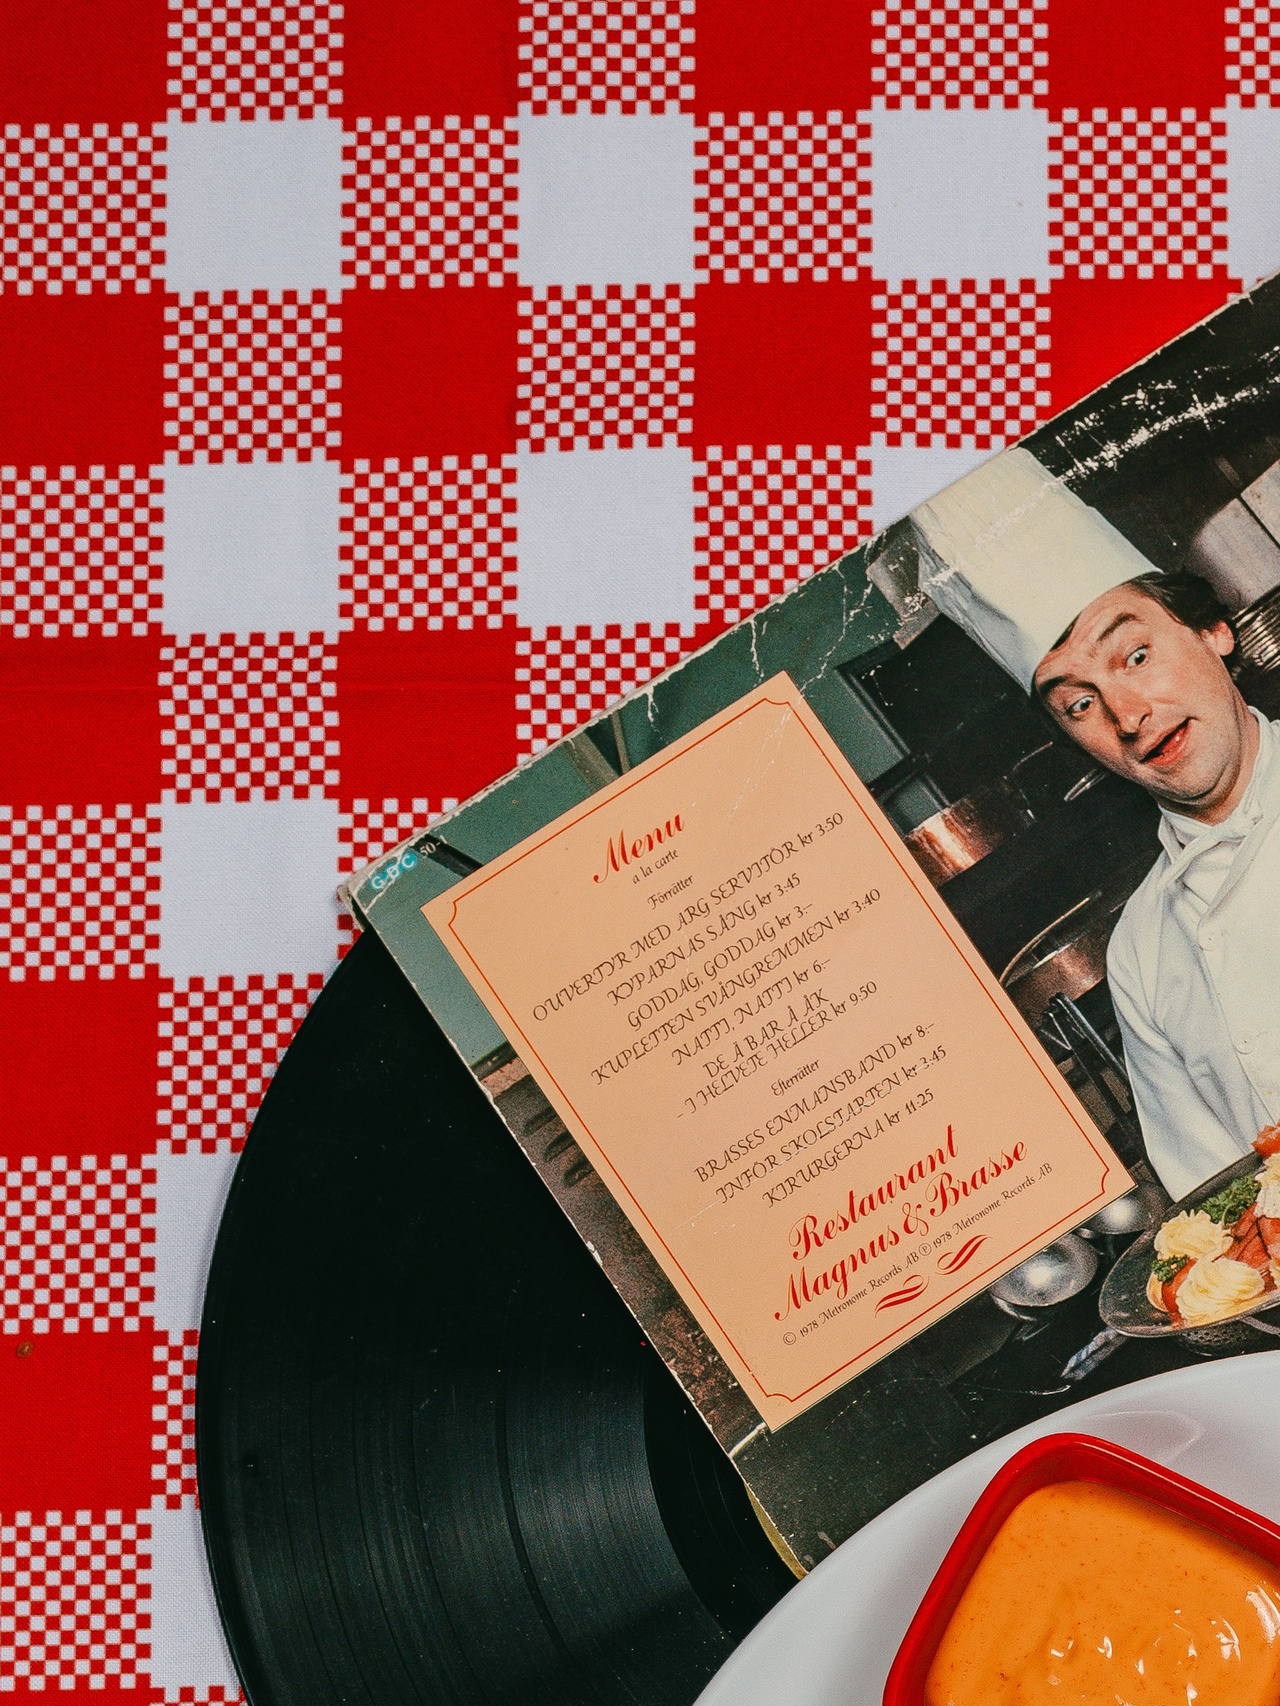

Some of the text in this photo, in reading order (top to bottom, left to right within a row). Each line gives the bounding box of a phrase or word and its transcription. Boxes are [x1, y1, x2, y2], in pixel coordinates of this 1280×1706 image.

[592, 814, 685, 884] Menu
[632, 849, 679, 885] a la carte
[647, 874, 693, 910] Förrätter
[532, 812, 844, 1022] OUVERTYR MED ARG SERVITÖR kr 3:50
[606, 872, 801, 1007] KYPARNAS SÅNG kr 3:45
[627, 971, 704, 1032] GODDAG,
[703, 921, 777, 982] GODDAG
[774, 913, 792, 930] kr
[590, 888, 881, 1086] KUPLETTEN SVÅNGREMMEN kr 3:40
[671, 1017, 735, 1066] NATTI,
[733, 976, 793, 1025] NATTI
[792, 968, 809, 986] kr
[695, 1050, 768, 1107] HELVETE
[765, 1009, 833, 1060] HELLER
[829, 1000, 847, 1017] kr
[848, 981, 878, 1007] 9:50
[701, 1053, 730, 1078] DE
[742, 1019, 785, 1051] BAR
[803, 987, 830, 1017] ÅK
[693, 1128, 766, 1183] BRASSES
[896, 1033, 913, 1050] kr
[715, 1044, 947, 1204] INFÖR SKOLSTARTEN kr 3:45
[770, 1059, 820, 1097] Efterrätter
[761, 1087, 934, 1209] KIRURGERNA kr 11:25
[788, 1124, 958, 1261] Restaurant
[774, 1141, 1027, 1321] Magnus & Brasse
[799, 1319, 819, 1338] 1978
[818, 1288, 868, 1325] Metronome
[867, 1264, 903, 1293] Records
[905, 1251, 920, 1269] AB
[932, 1230, 953, 1249] 1978
[952, 1199, 1001, 1236] Metronome
[1000, 1175, 1036, 1201] Records
[1038, 1162, 1053, 1181] AB
